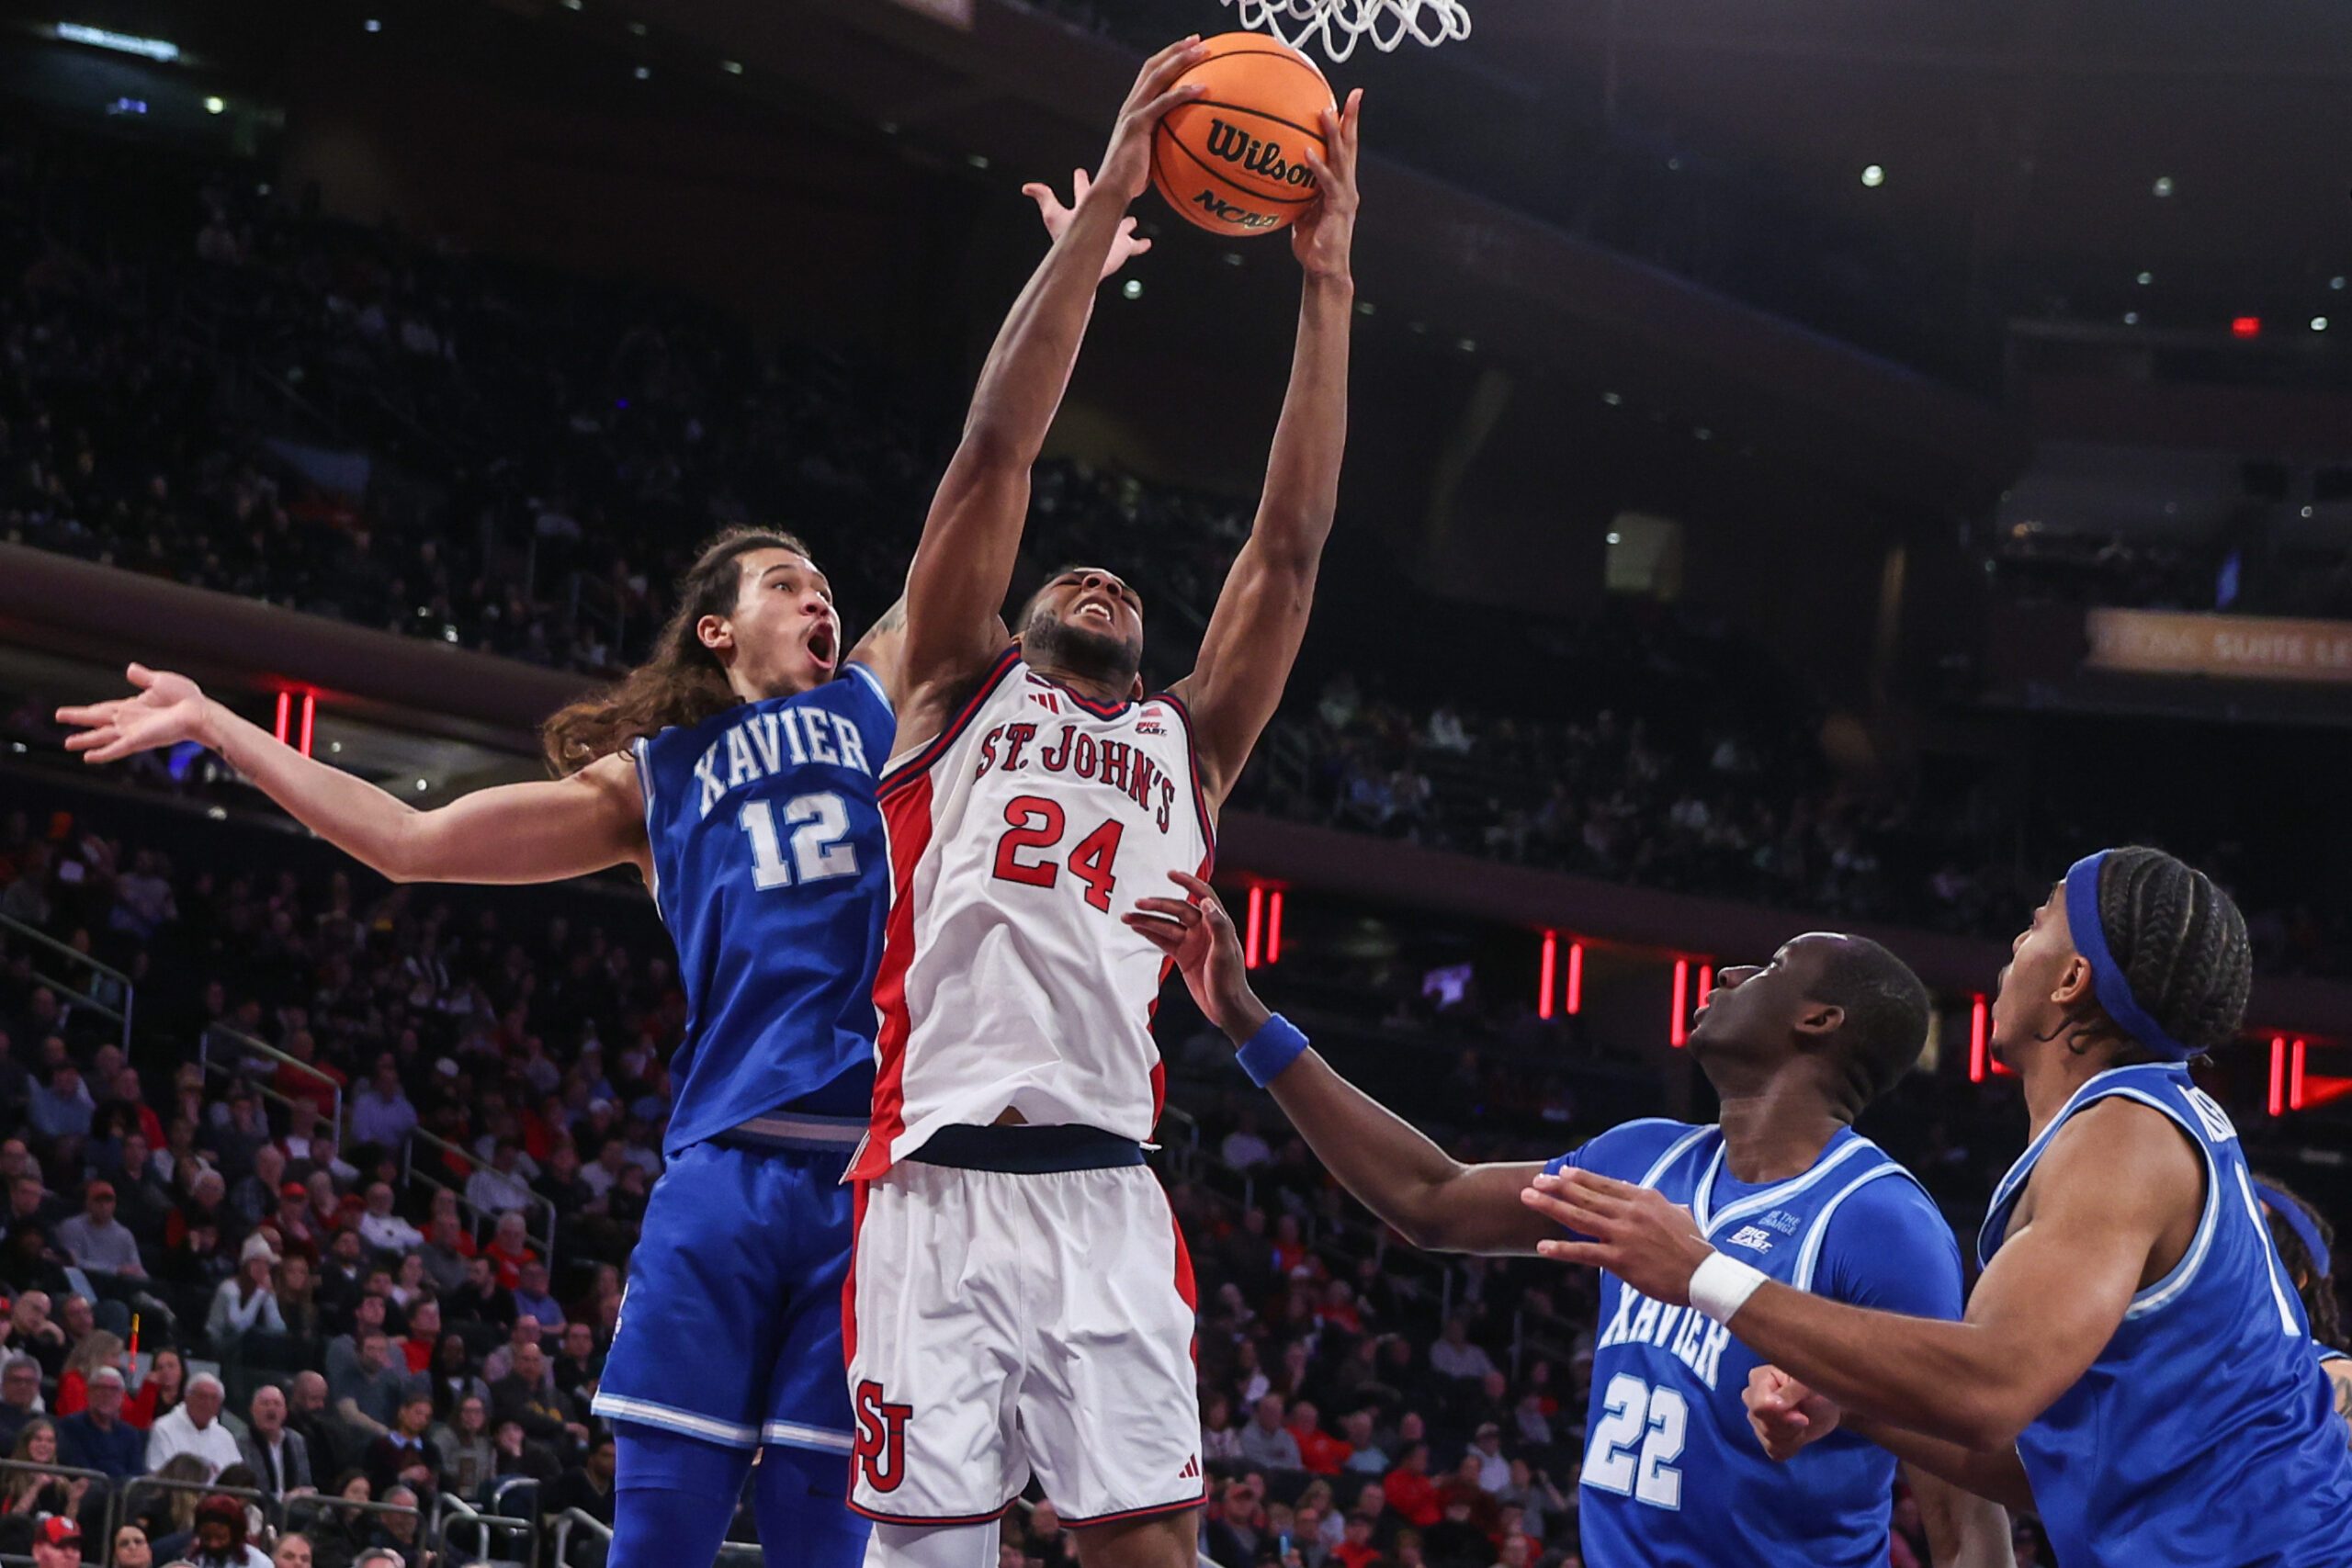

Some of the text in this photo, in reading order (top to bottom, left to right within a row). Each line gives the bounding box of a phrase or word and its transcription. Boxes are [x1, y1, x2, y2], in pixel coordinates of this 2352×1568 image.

[1193, 189, 1279, 229] NCAA
[694, 705, 873, 820] XAVIER
[972, 723, 1175, 834] ST. JOHN'S
[738, 790, 862, 892] 12
[992, 795, 1125, 914] 24
[1738, 1225, 1770, 1240] BIG
[1781, 1211, 1802, 1226] THE
[1579, 1371, 1689, 1511] 22
